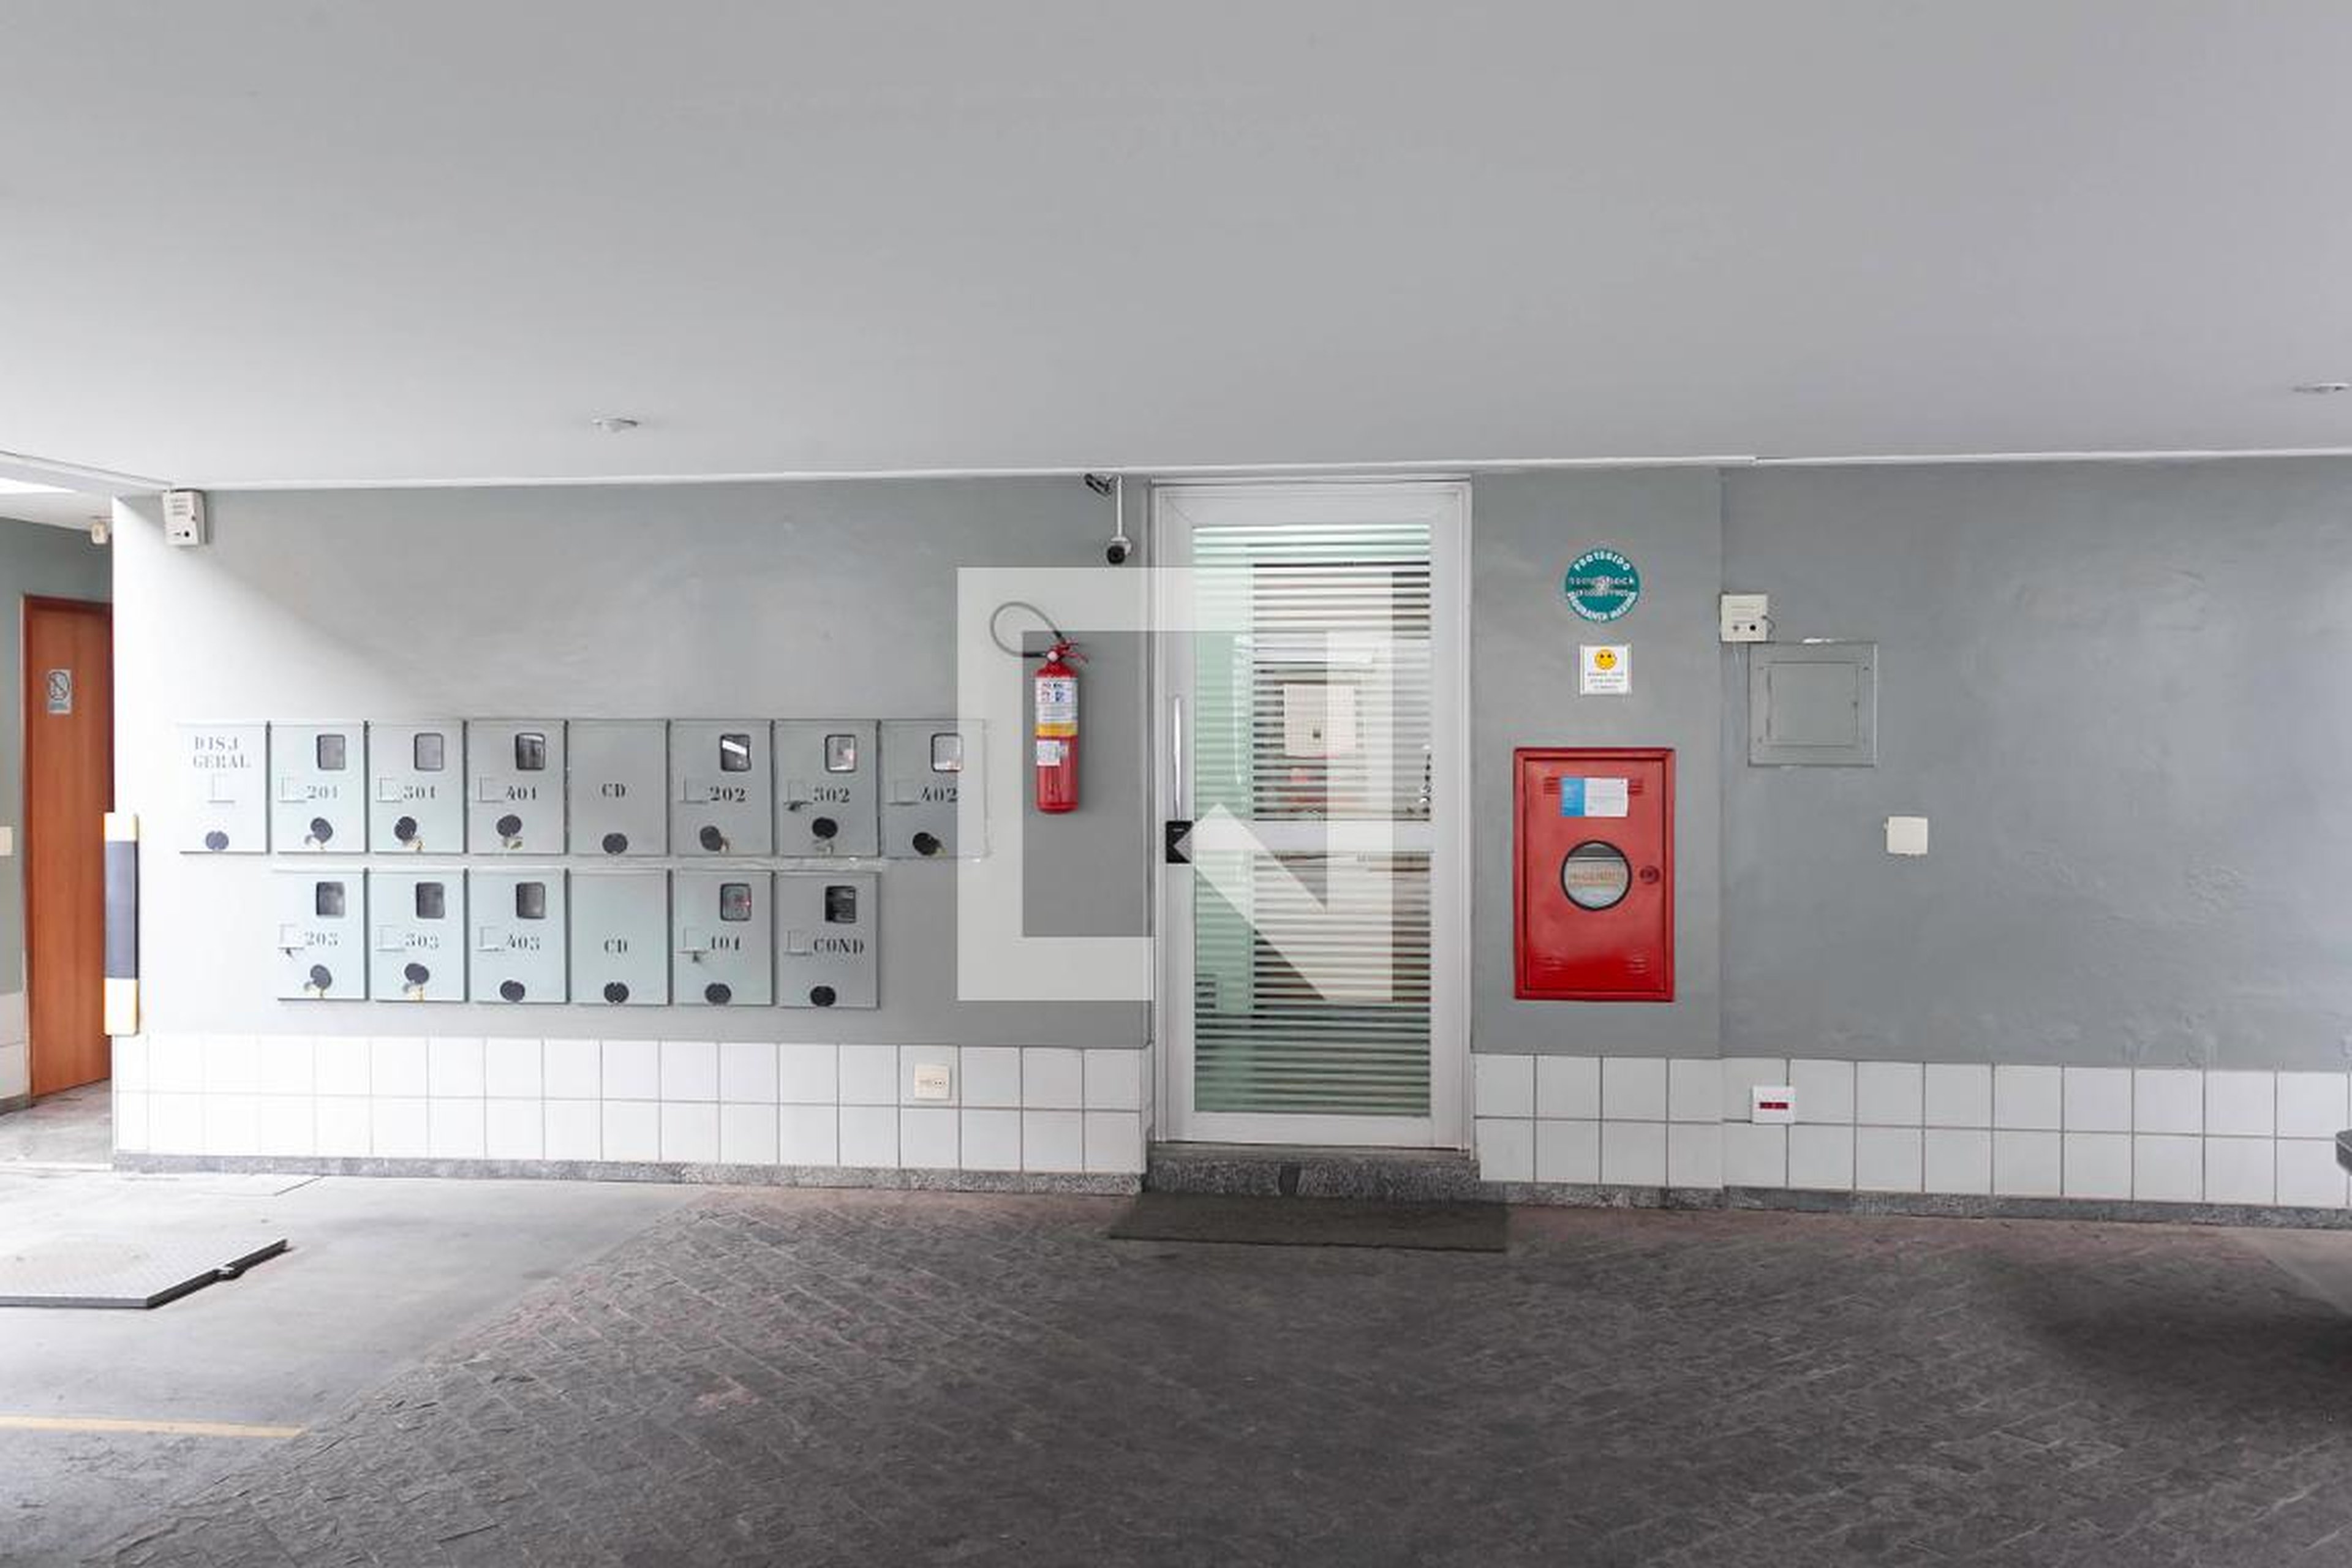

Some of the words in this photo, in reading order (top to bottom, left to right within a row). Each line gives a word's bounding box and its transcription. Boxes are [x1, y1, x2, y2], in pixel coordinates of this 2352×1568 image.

[192, 753, 252, 769] GERAL
[306, 785, 340, 800] 201
[402, 785, 437, 799] 301
[505, 785, 538, 800] 401
[601, 783, 627, 799] CD
[709, 786, 747, 802] 202
[813, 787, 851, 803] 302
[919, 787, 958, 803] 402
[304, 931, 340, 946] 203
[405, 932, 440, 949] 303
[505, 932, 541, 949] 403
[604, 938, 628, 954] CD
[710, 936, 743, 951] 101
[813, 938, 865, 954] COND
